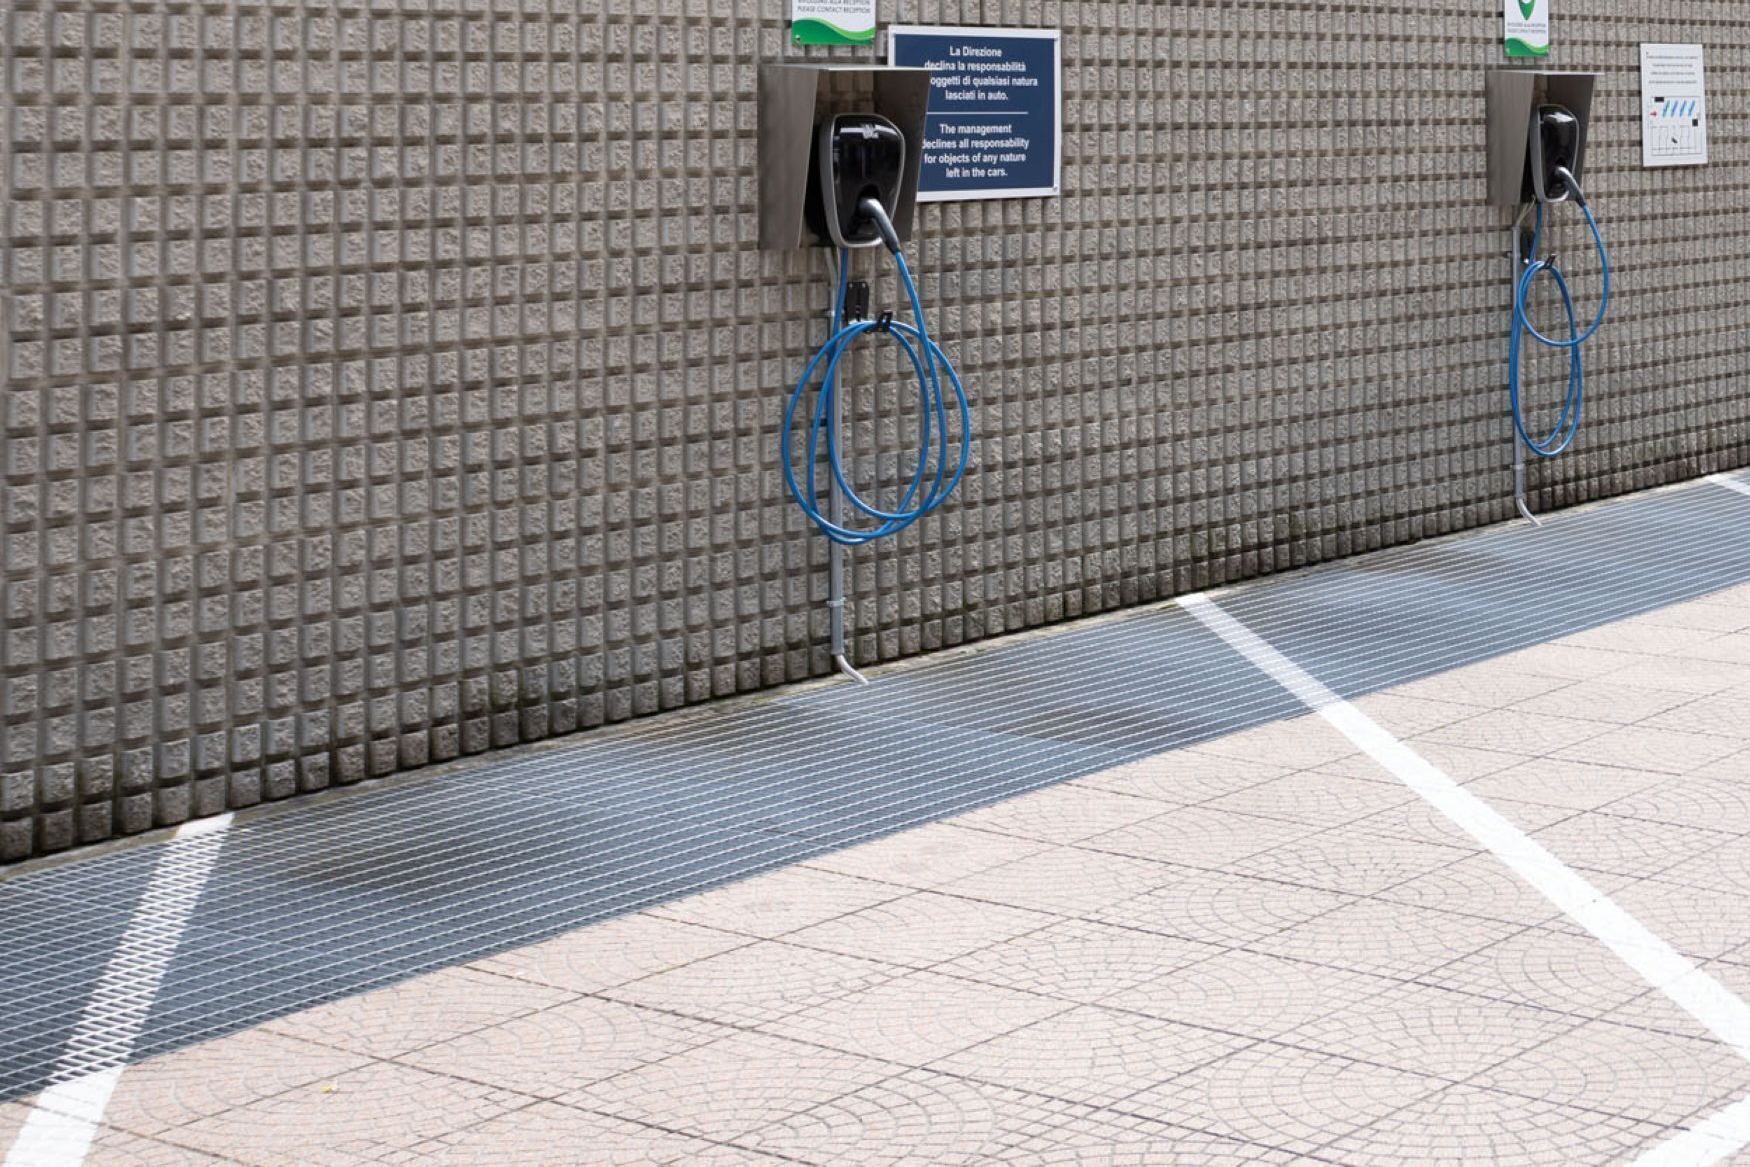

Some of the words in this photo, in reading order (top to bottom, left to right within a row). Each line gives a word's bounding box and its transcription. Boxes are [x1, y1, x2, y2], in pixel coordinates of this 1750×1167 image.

[949, 45, 961, 56] La
[962, 46, 1003, 57] Direzione
[924, 60, 956, 71] declina
[957, 61, 965, 71] la
[967, 61, 1026, 73] responsabilità
[930, 75, 961, 88] oggetti
[962, 76, 971, 86] di
[972, 75, 1010, 88] qualsiasi
[1011, 77, 1038, 86] natura
[945, 89, 976, 101] lasciati
[977, 90, 986, 100] in
[987, 90, 1008, 101] auto.
[940, 123, 957, 134] The
[958, 124, 1012, 136] management
[958, 138, 969, 149] all
[971, 137, 1030, 150] responsability
[924, 153, 936, 164] for
[938, 153, 971, 166] objects
[972, 153, 982, 163] of
[982, 154, 998, 165] any
[1000, 153, 1027, 162] nature
[945, 167, 961, 178] left
[962, 167, 971, 177] in
[972, 167, 986, 178] the
[987, 168, 1008, 177] cars.
